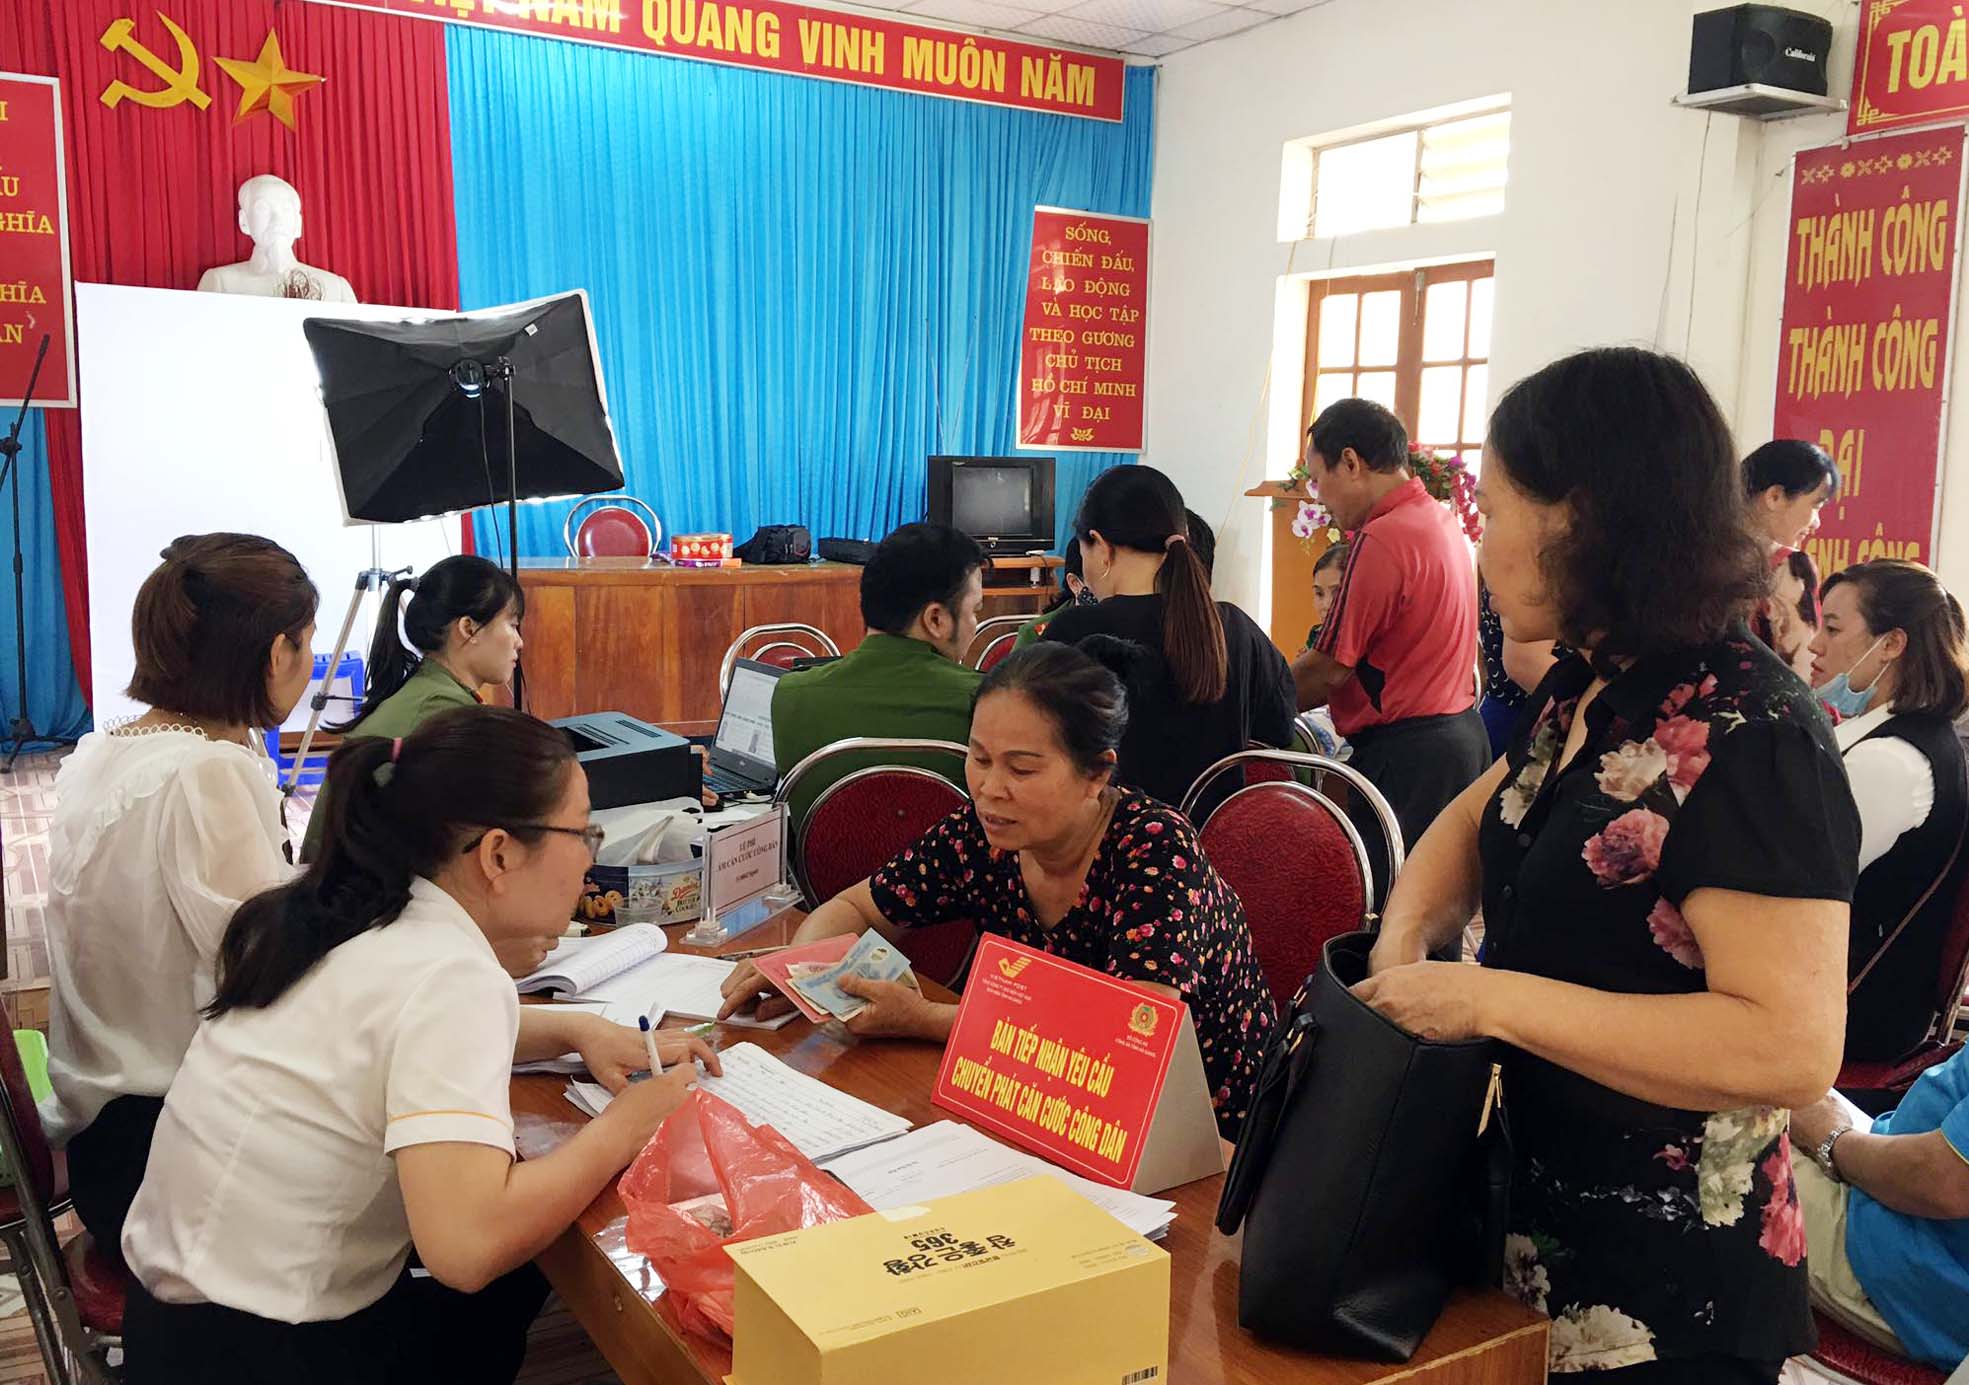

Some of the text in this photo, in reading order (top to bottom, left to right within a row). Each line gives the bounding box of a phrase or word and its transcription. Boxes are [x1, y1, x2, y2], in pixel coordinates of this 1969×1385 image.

[642, 0, 780, 58] QUANG
[798, 18, 885, 75] VINH
[902, 37, 1006, 93] MUÔN
[1020, 53, 1096, 106] NĂM
[1785, 47, 1816, 62] California
[1065, 221, 1111, 245] SỐNG,
[1796, 185, 1948, 294] THÀNH CÔNG
[1042, 247, 1094, 268] CHIẾN
[1041, 277, 1130, 298] LAO ĐỘNG
[1041, 296, 1139, 325] VÀ HỌC TẬP
[1029, 327, 1135, 348] THEO GƯƠNG
[1045, 349, 1122, 374] CHỦ TỊCH
[1788, 303, 1939, 400] THÀNH CÔNG
[1031, 372, 1136, 397] HỒ CHÍ MINH
[1053, 402, 1111, 423] VĨ ĐẠI
[990, 1016, 1016, 1057] BÀN
[1012, 1024, 1039, 1065] TIẾP
[1035, 1037, 1069, 1082] NHẬN
[1066, 1047, 1091, 1088] YÊU
[1087, 1052, 1115, 1098] CẦU
[951, 1055, 1127, 1163] CHUYỂN PHÁT CĂN CƯỚC CÔNG DÂN
[911, 1232, 959, 1252] 365
[935, 1240, 988, 1262] 좋은
[986, 1234, 1016, 1250] 참
